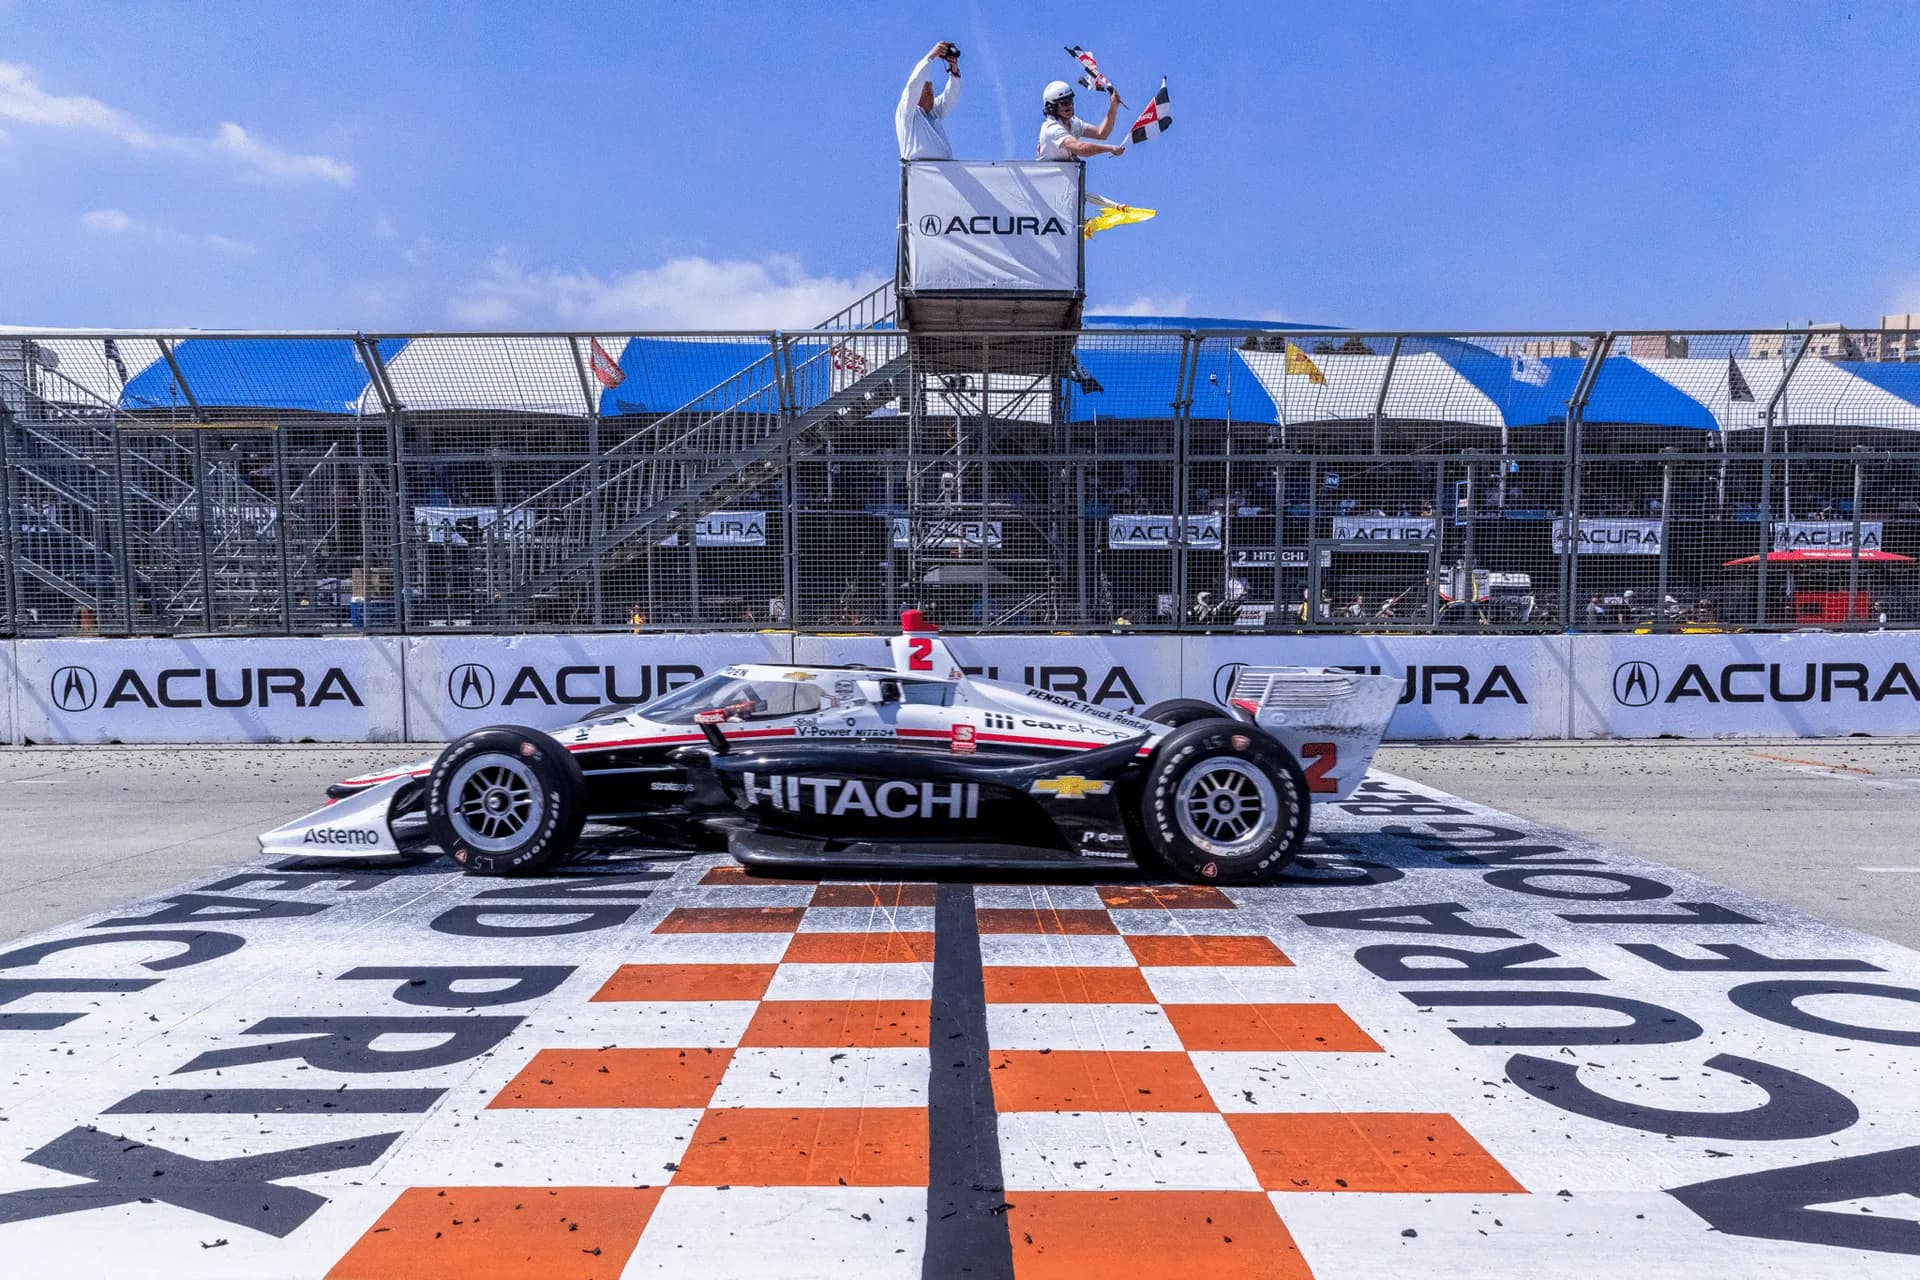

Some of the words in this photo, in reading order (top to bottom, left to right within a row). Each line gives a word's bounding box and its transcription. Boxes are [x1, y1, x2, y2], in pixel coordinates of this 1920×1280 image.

[944, 215, 1066, 236] ACURA
[696, 521, 764, 536] CURA
[1129, 526, 1219, 540] ACURA
[1577, 530, 1659, 544] ACURA
[1238, 551, 1247, 564] 2
[908, 637, 933, 671] 2
[104, 667, 364, 708] ACURA
[500, 664, 705, 706] ACUR
[1664, 662, 1920, 703] ACURA
[1021, 718, 1131, 740] carshop
[1026, 688, 1078, 709] PENSKE
[1080, 704, 1112, 720] Truck
[1112, 714, 1152, 731] Rental
[797, 727, 851, 737] V-Power
[1301, 742, 1339, 794] 2
[743, 772, 979, 819] HITACHI
[302, 827, 379, 845] Astemo
[513, 791, 561, 865] Firestone
[1380, 822, 1764, 925] LONG
[1296, 901, 1920, 1256] ACURA
[0, 965, 579, 1239] PRIX
